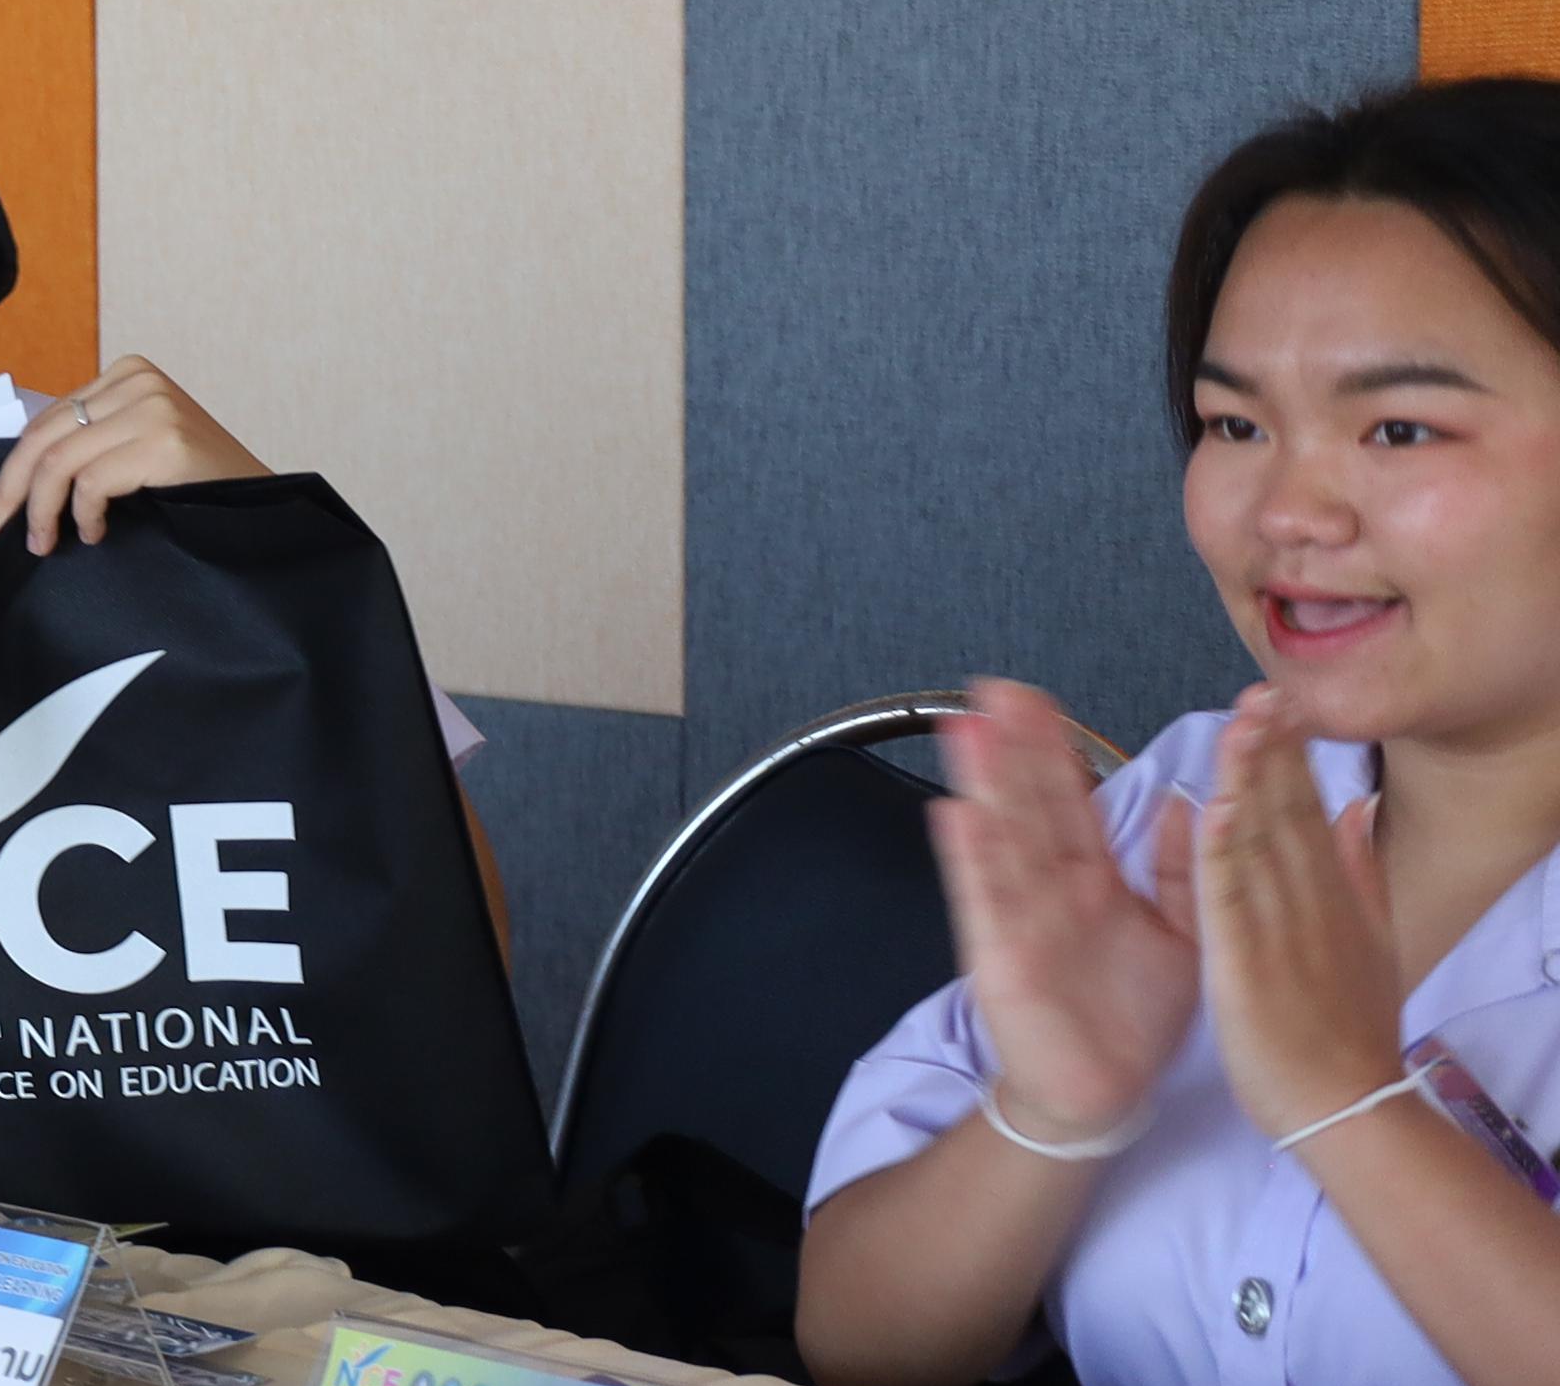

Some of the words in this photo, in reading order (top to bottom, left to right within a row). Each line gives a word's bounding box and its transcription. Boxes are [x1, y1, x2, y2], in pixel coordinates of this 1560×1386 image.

[19, 1005, 313, 1059] NATIONAL
[49, 1068, 104, 1099] ON
[122, 1056, 321, 1098] EDUCATION
